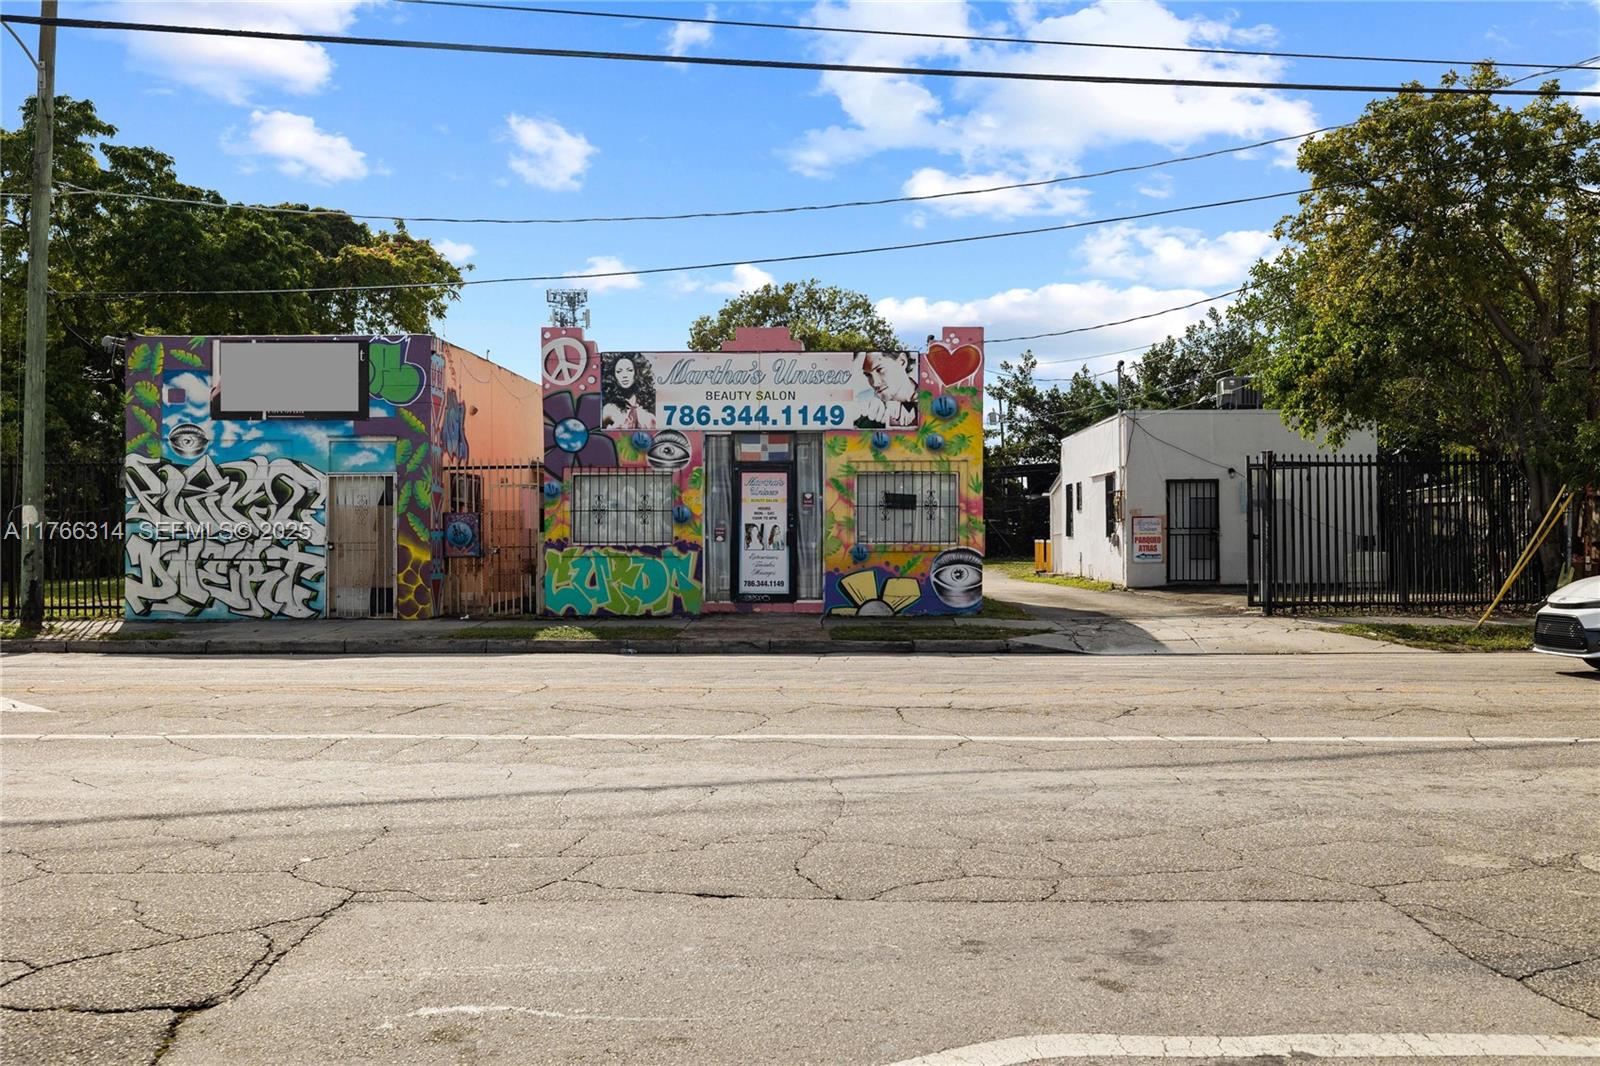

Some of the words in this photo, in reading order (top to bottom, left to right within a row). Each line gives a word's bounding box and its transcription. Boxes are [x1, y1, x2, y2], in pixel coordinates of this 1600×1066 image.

[657, 357, 766, 386] Martha's
[771, 357, 852, 386] Unisex
[705, 390, 751, 401] BEAUTY
[756, 390, 796, 401] SALON
[663, 404, 845, 426] 786.344.1149
[743, 580, 785, 588] 786.344.1149
